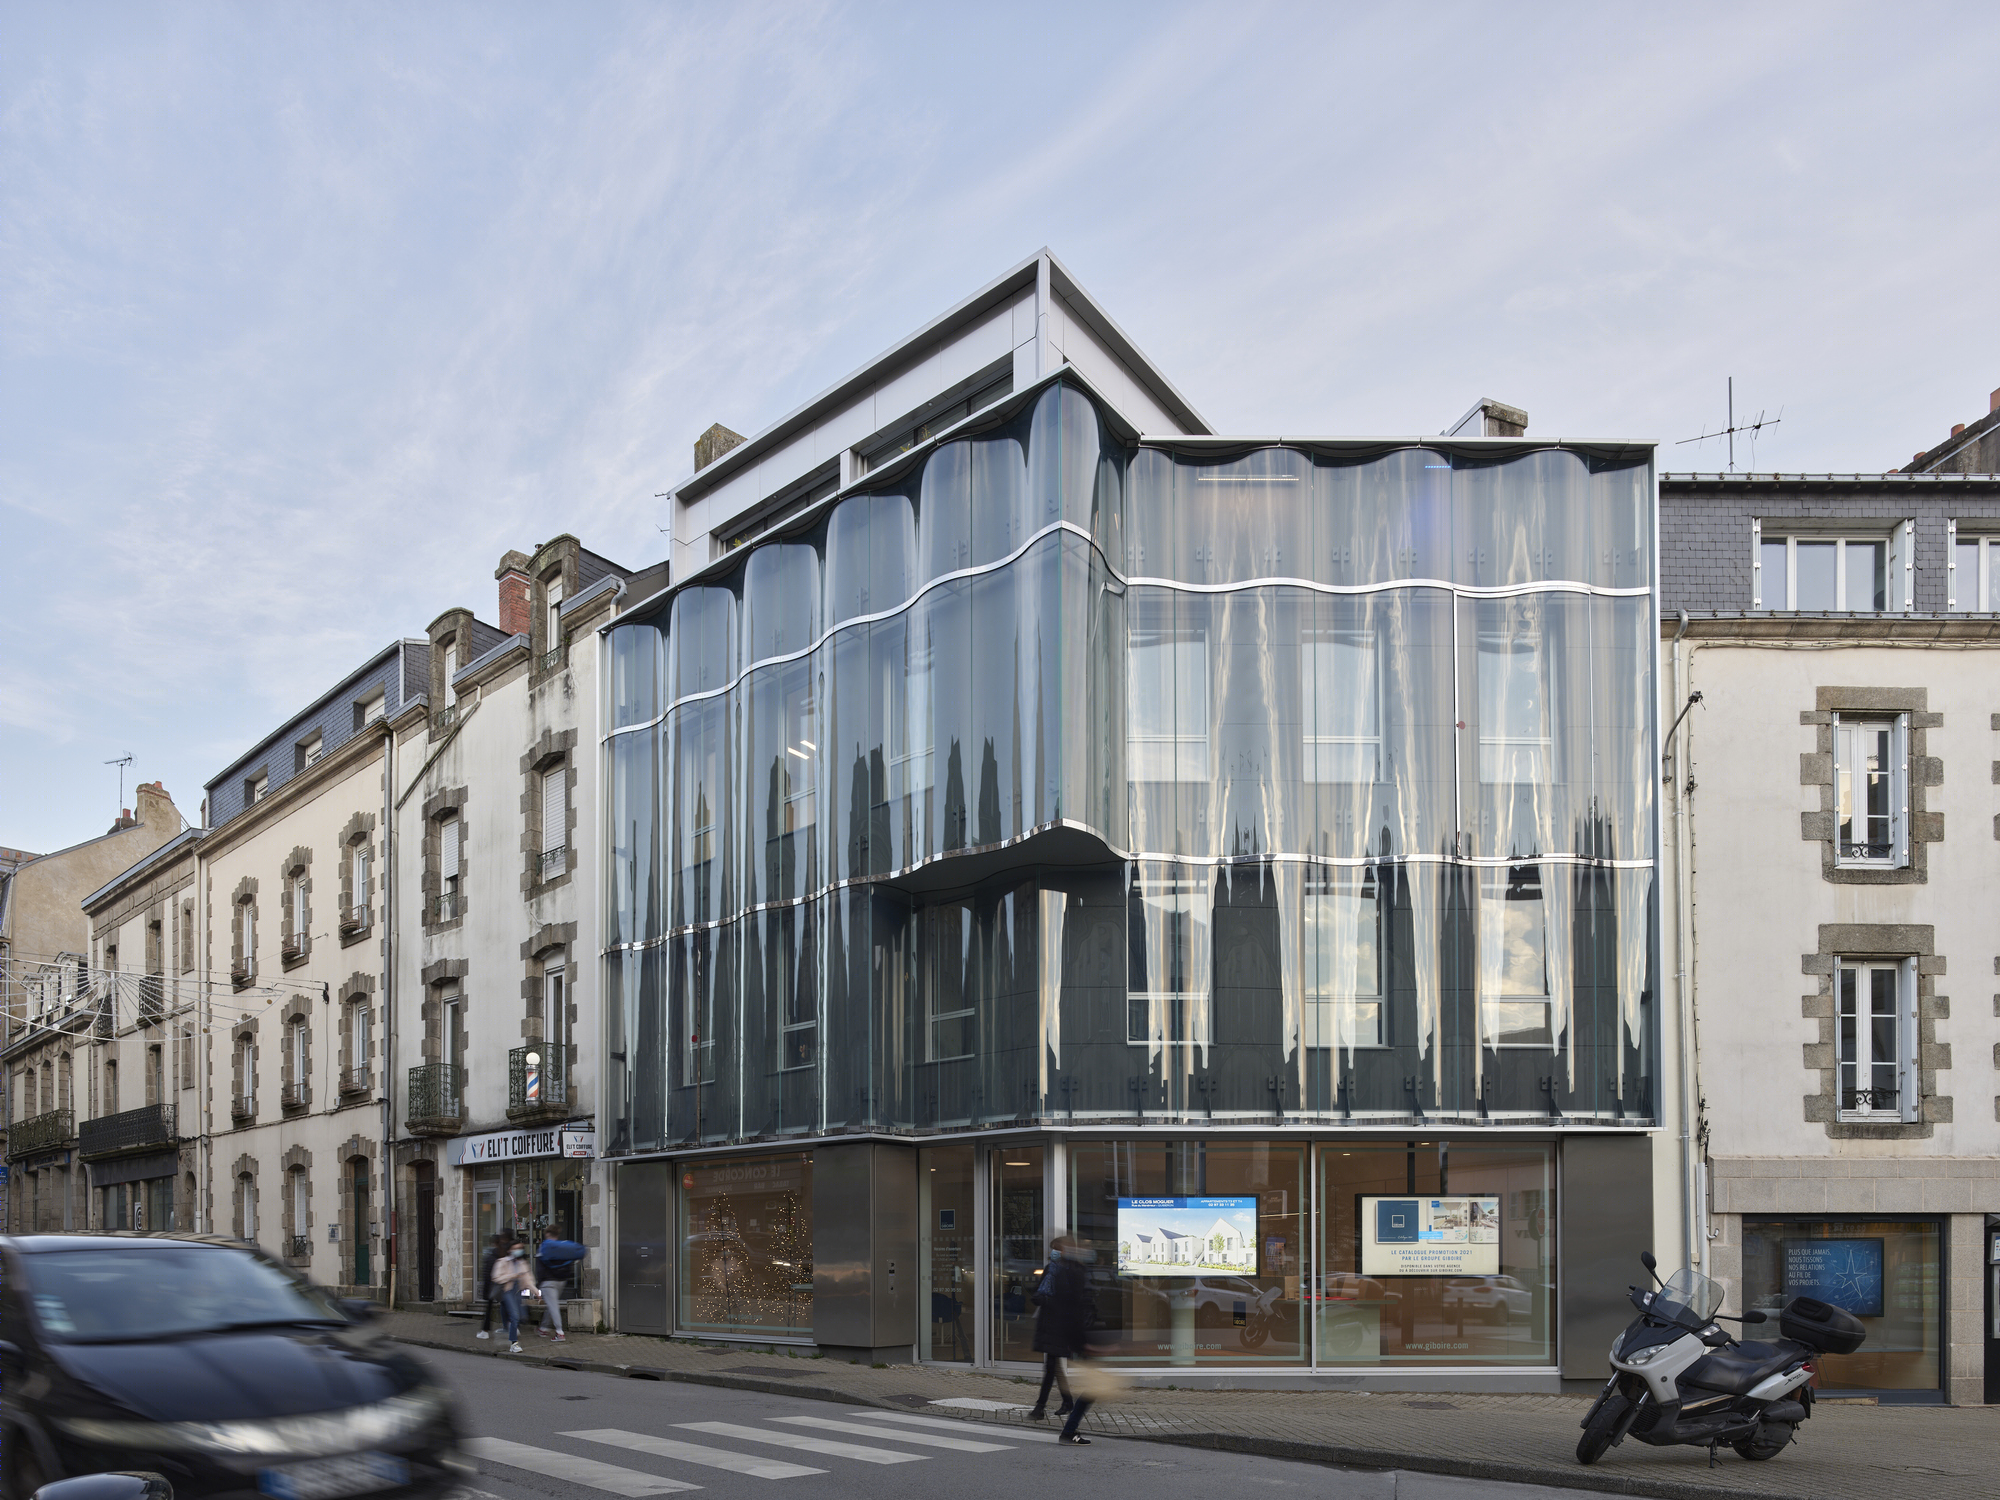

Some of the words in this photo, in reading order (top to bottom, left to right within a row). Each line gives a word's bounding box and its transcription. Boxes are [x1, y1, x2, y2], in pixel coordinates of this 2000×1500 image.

[487, 1137, 509, 1158] ELI'T
[512, 1131, 555, 1156] COIFFURE
[1788, 1248, 1800, 1256] PLUS
[1801, 1248, 1811, 1256] QUE
[1812, 1248, 1832, 1256] JAMAIS,
[1157, 1342, 1222, 1351] www.giboire.com
[1405, 1342, 1469, 1351] www.giboire.com
